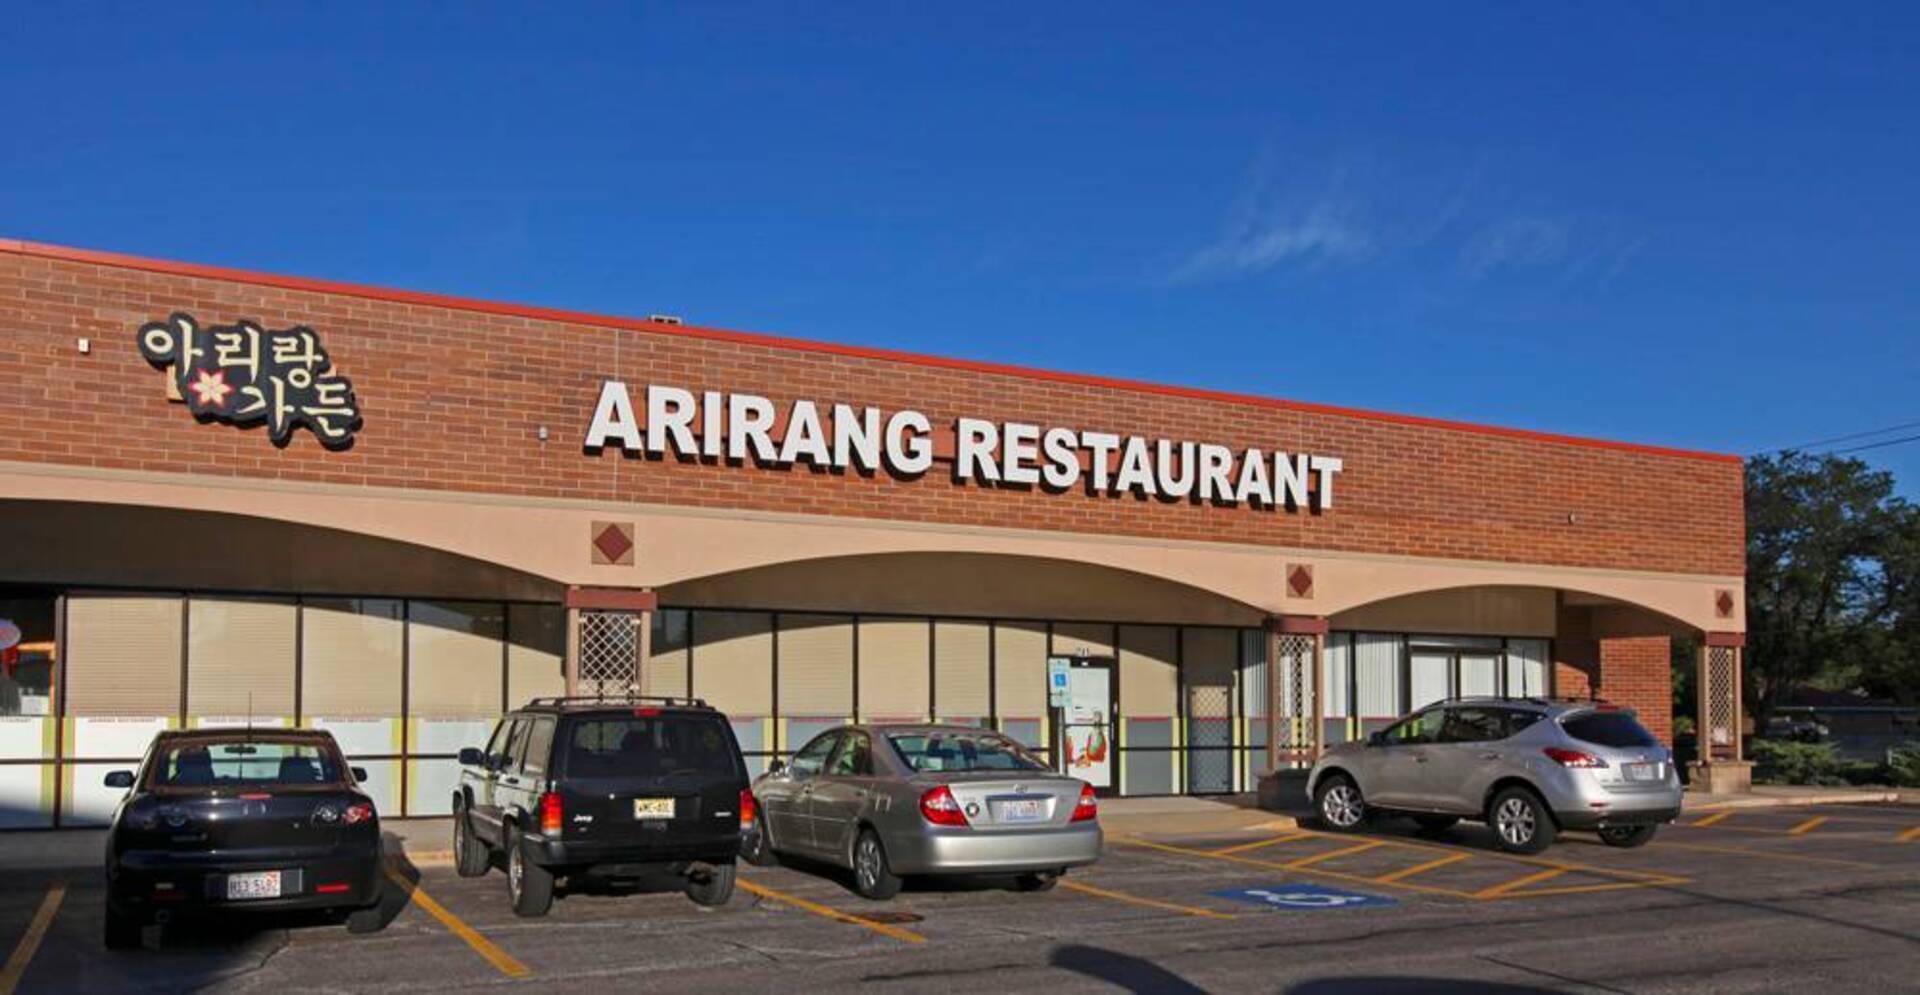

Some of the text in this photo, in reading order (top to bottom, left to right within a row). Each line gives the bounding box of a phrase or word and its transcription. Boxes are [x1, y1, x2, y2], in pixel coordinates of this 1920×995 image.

[144, 318, 323, 389] 아리랑
[236, 374, 355, 438] 가든
[584, 380, 1344, 510] ARIRANG RESTAURANT
